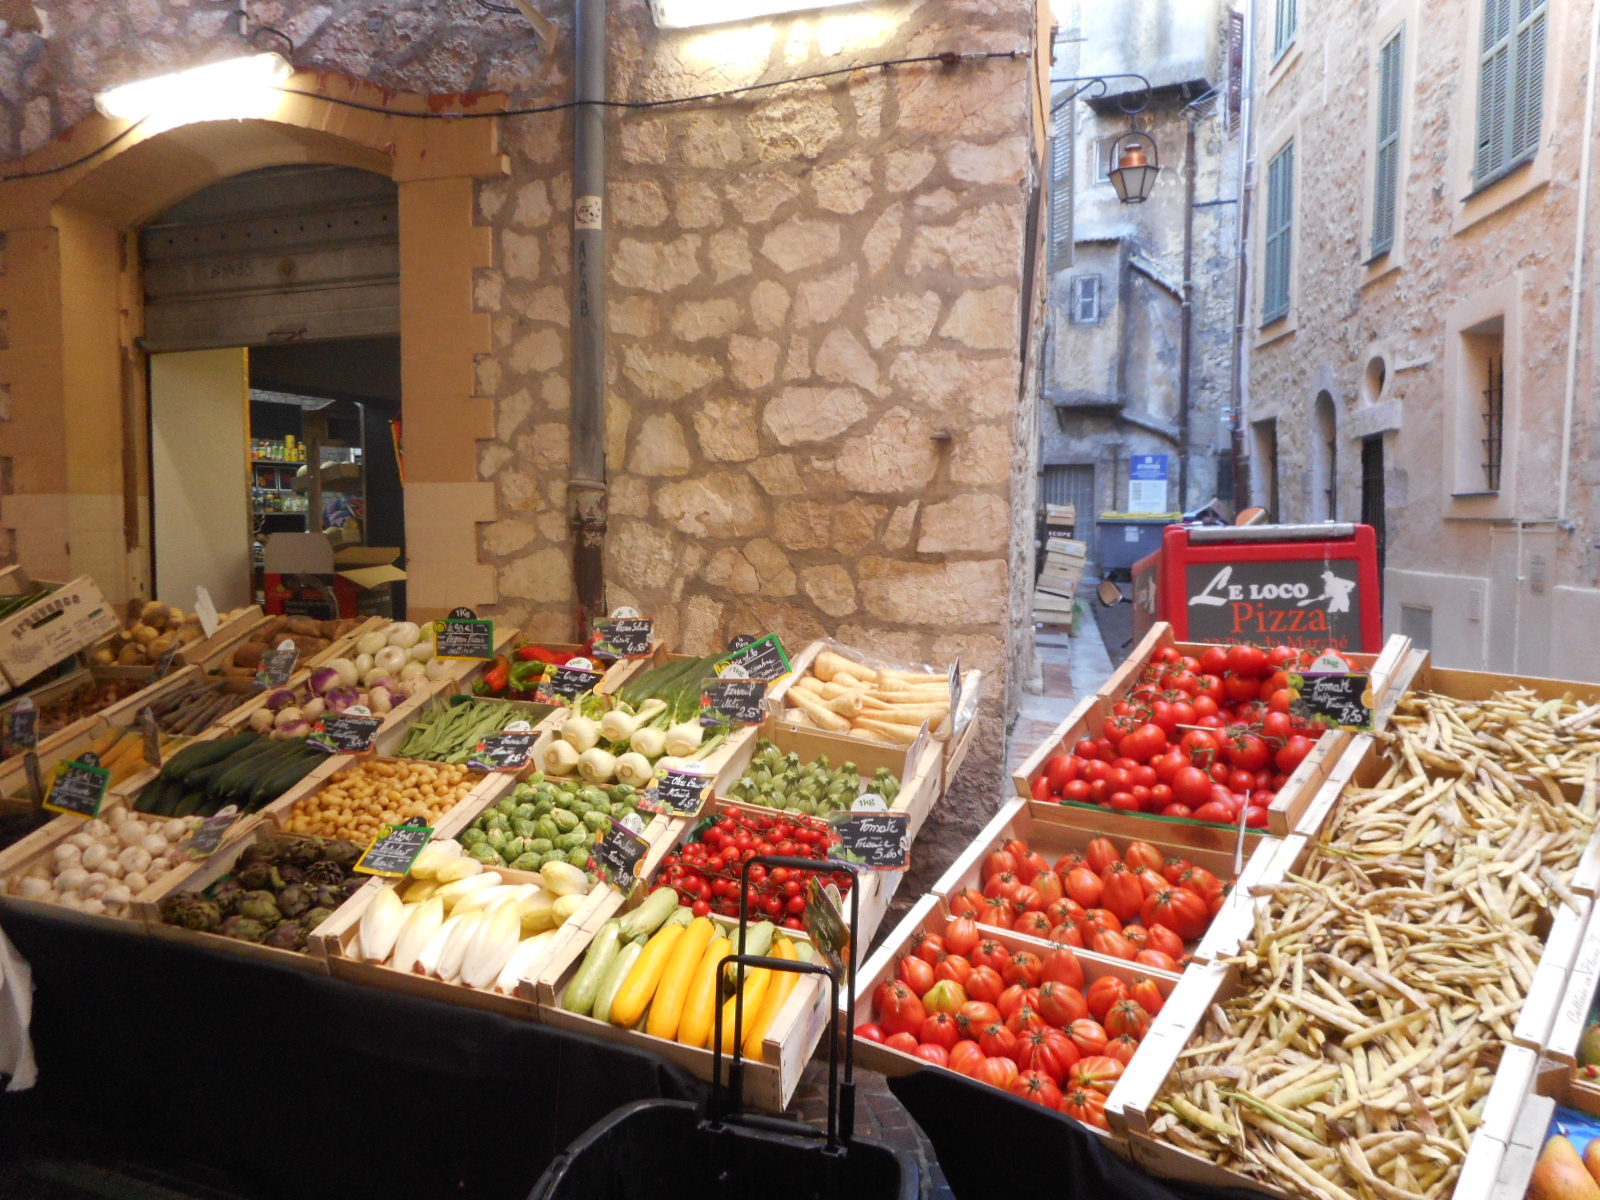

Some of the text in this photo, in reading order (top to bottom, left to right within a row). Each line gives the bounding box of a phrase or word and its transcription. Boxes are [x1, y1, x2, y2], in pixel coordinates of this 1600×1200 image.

[1249, 583, 1309, 600] LOCO
[1231, 602, 1328, 633] Pizza
[859, 818, 899, 833] Tomate
